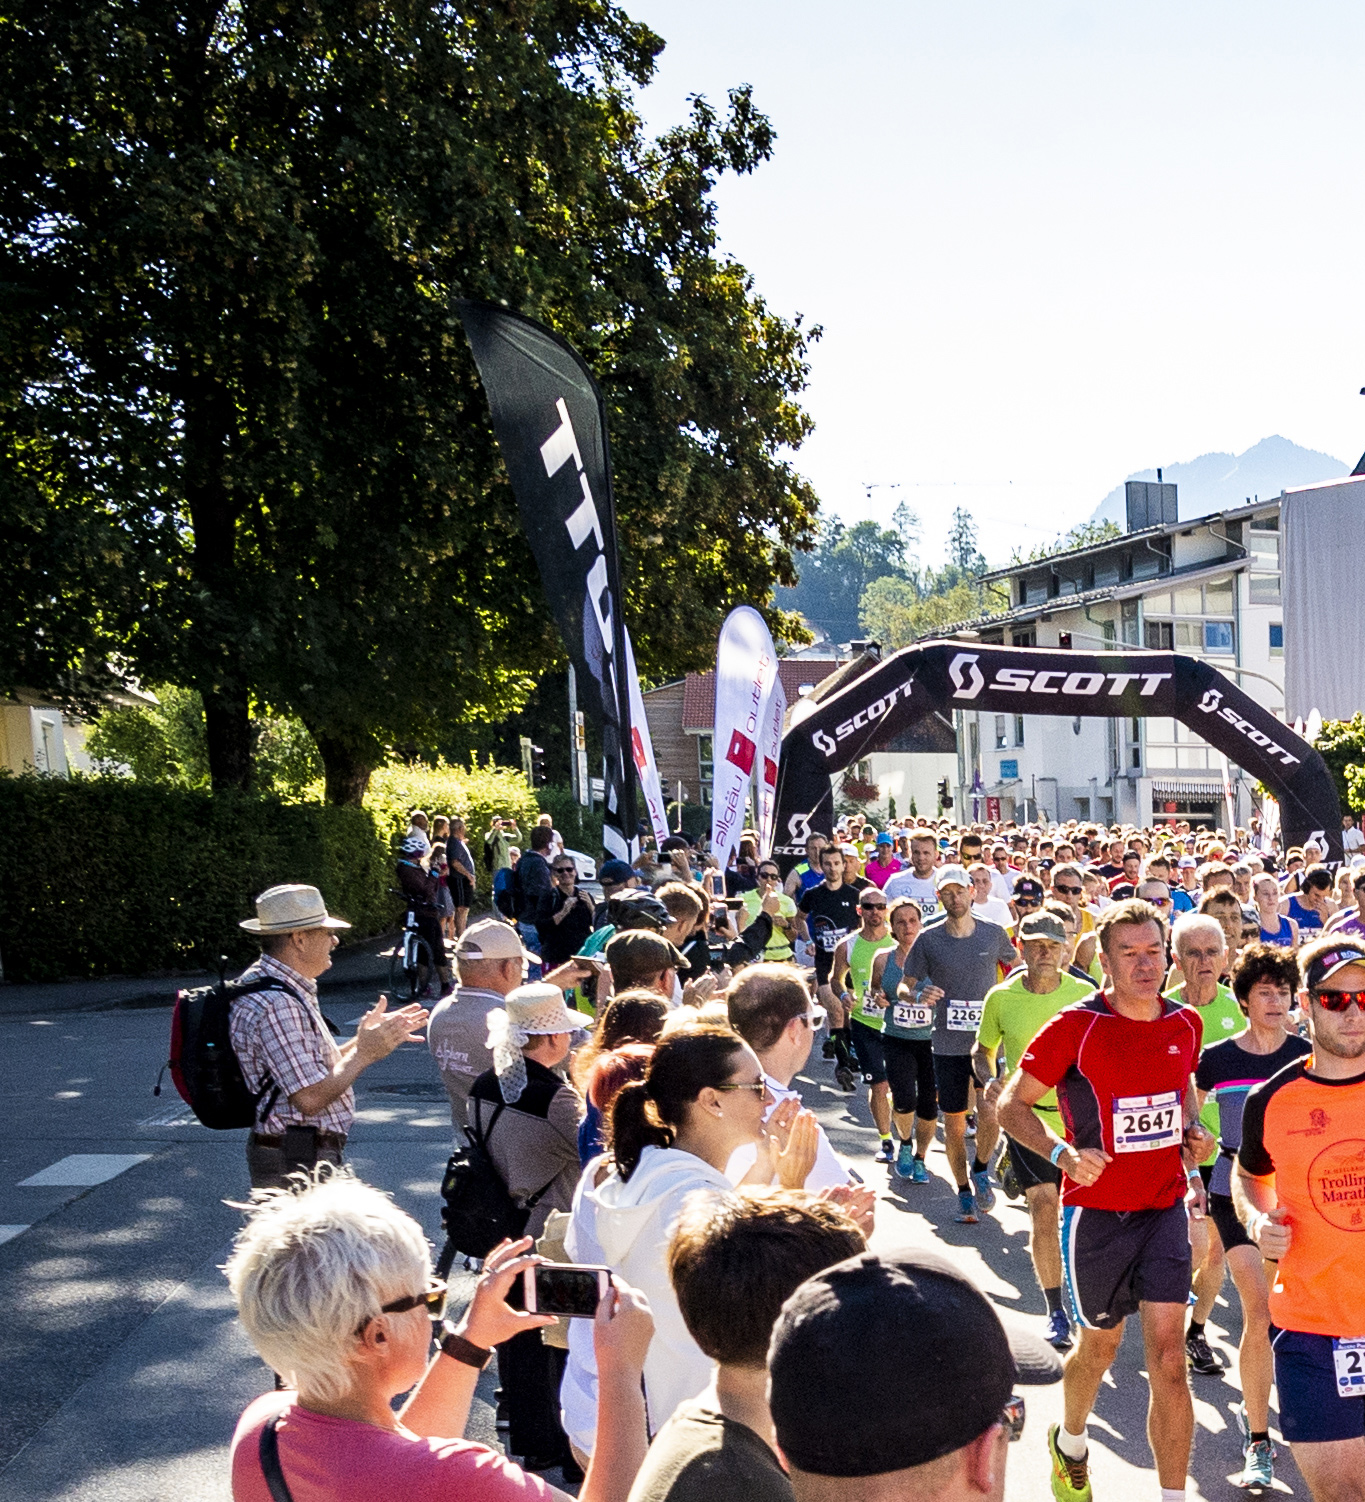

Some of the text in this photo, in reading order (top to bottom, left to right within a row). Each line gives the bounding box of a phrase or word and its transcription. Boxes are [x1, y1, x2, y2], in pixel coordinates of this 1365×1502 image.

[989, 669, 1172, 696] SCOTT
[836, 678, 914, 741] SCOTT
[716, 655, 770, 847] allgäu outlet
[1217, 708, 1301, 765] SCOTT
[899, 1007, 926, 1020] 2110
[1123, 1109, 1174, 1134] 2647
